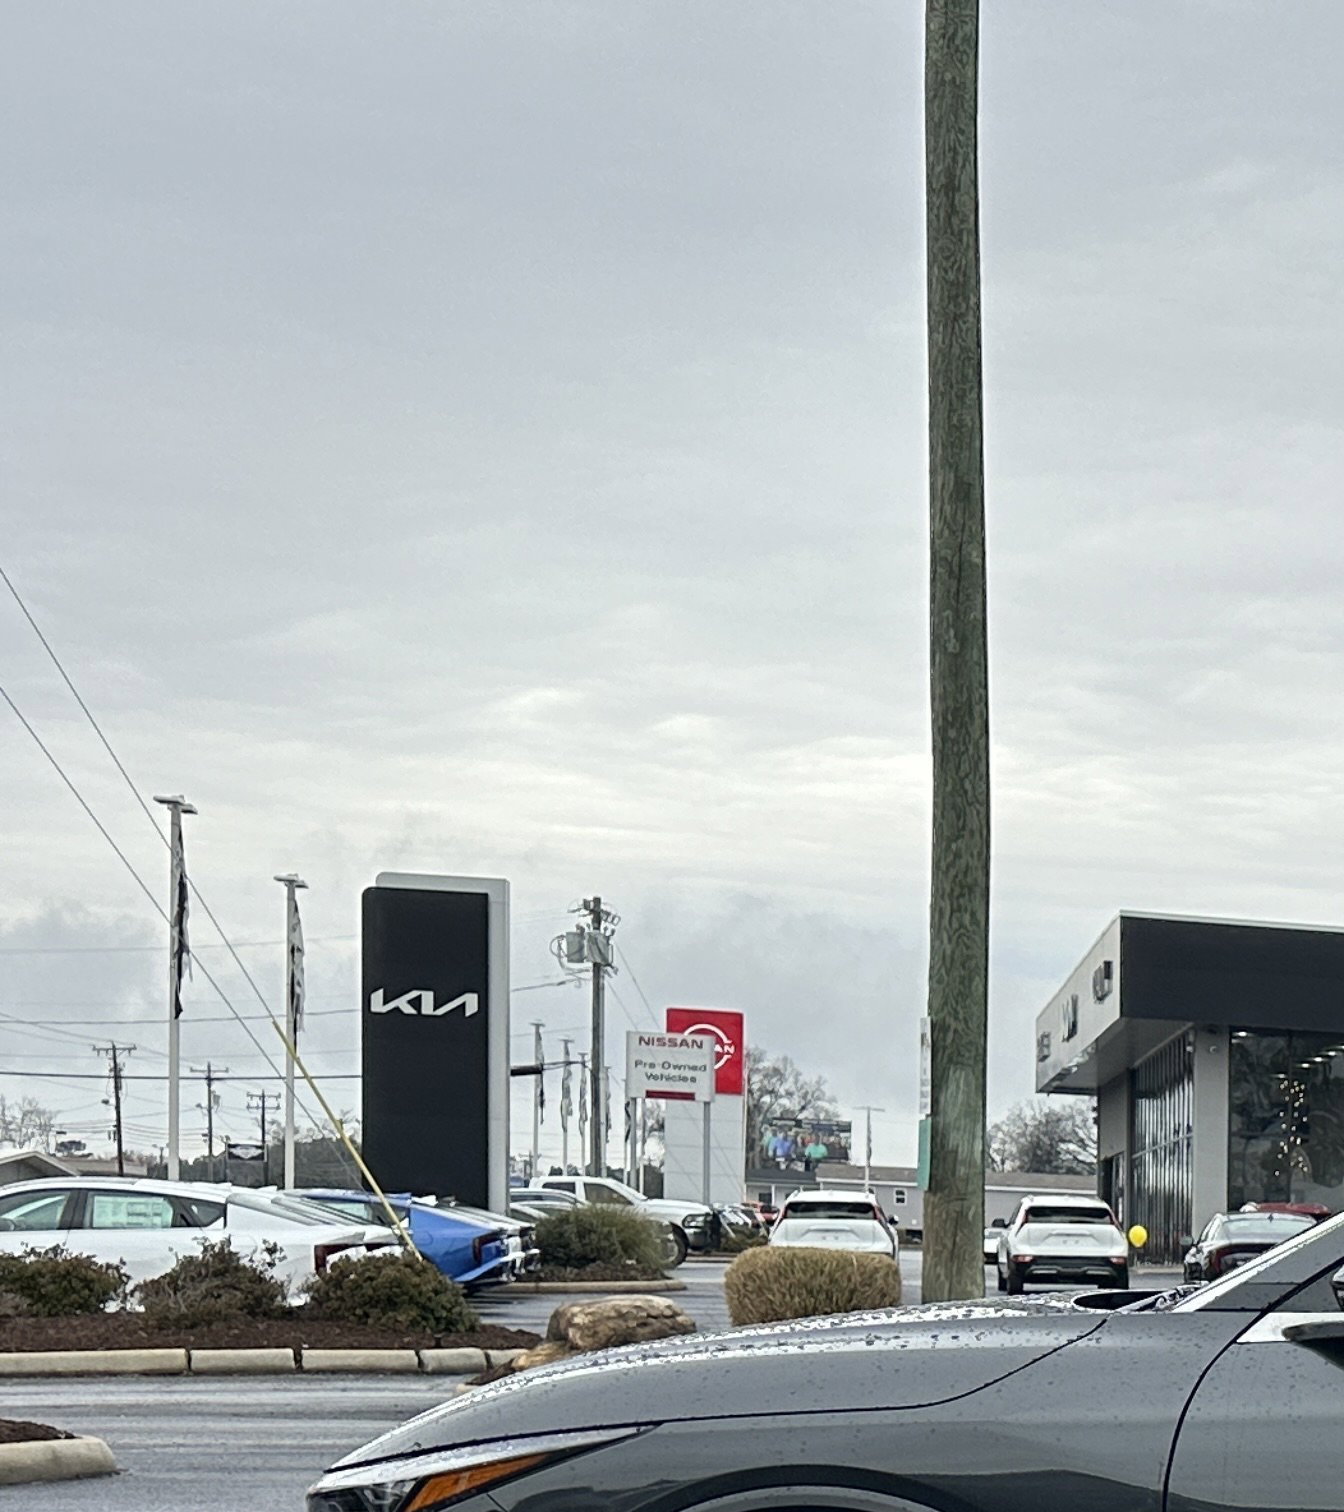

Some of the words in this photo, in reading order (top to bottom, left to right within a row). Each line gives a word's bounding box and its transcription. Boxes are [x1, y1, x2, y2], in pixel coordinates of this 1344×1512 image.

[370, 987, 479, 1017] KIA
[638, 1035, 704, 1049] NISSAN
[645, 1072, 697, 1083] Vehicles
